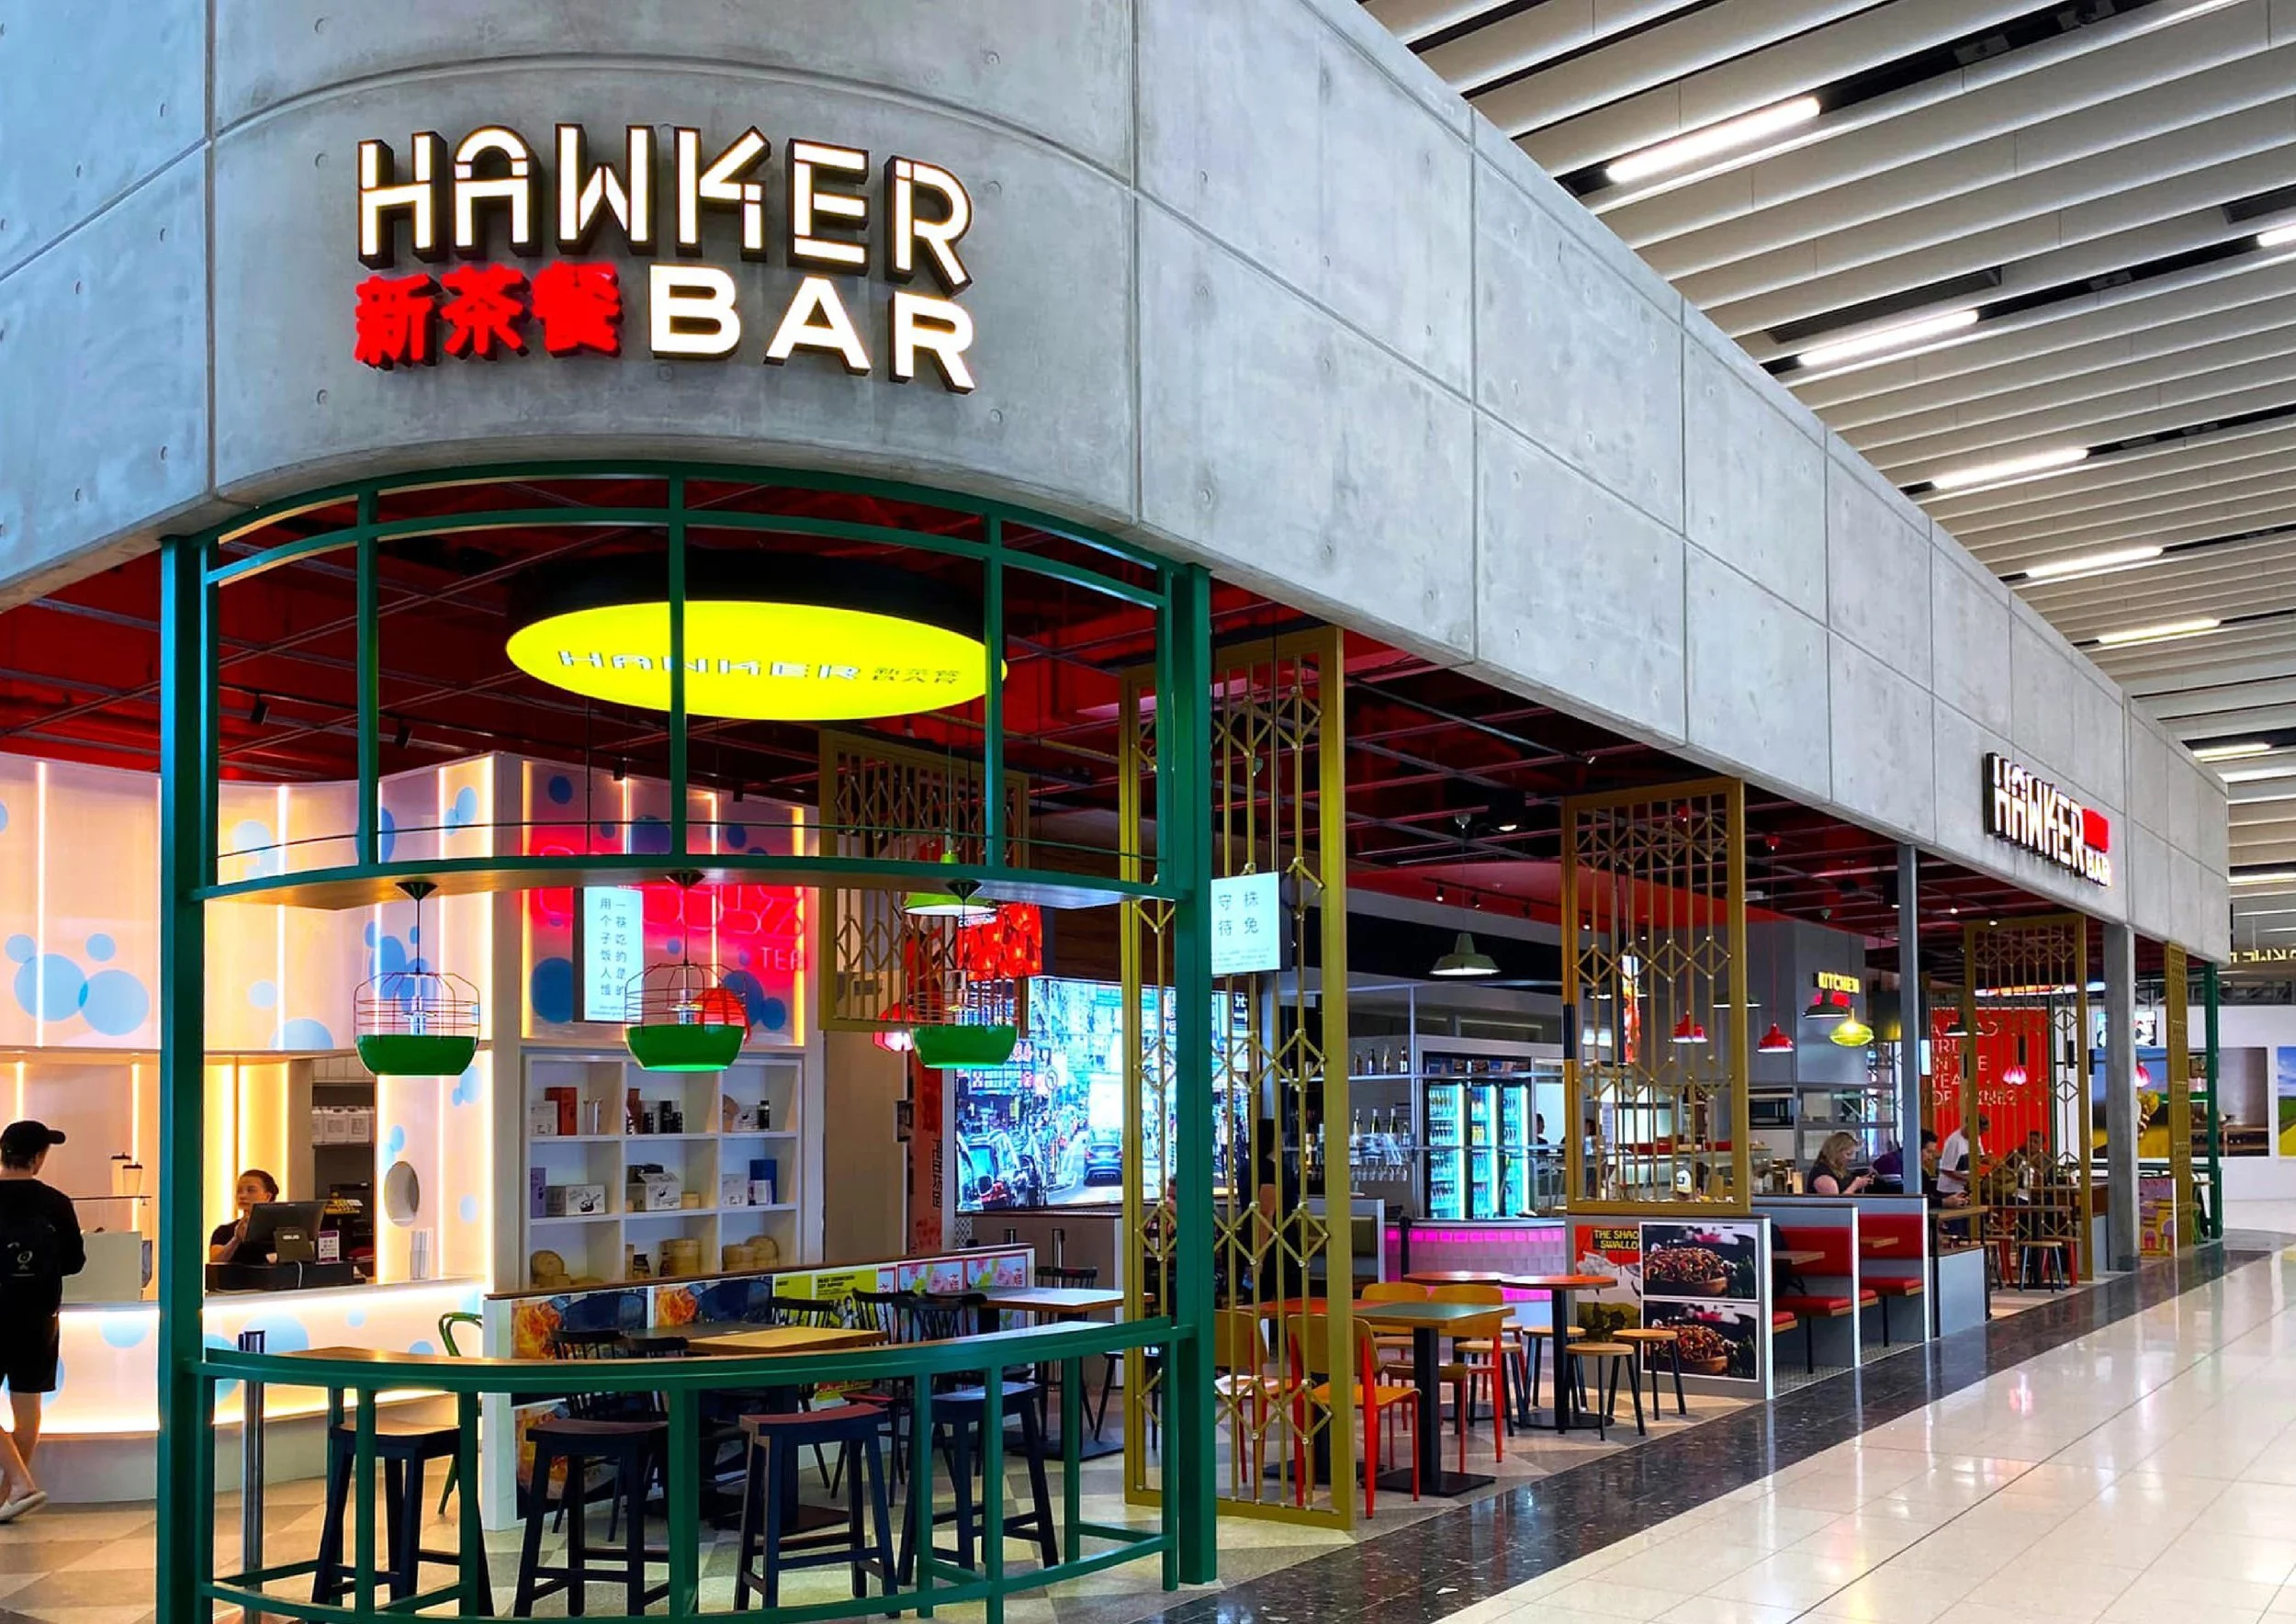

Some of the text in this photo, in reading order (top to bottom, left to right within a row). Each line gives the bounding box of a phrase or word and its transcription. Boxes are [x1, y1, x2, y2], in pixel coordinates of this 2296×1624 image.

[358, 123, 974, 295] HAWKER
[355, 261, 625, 369] 新茶餐
[647, 263, 977, 394] BAR
[1986, 751, 2086, 877] HAWKER
[2084, 846, 2111, 886] BAR
[1593, 1229, 1612, 1240] THE
